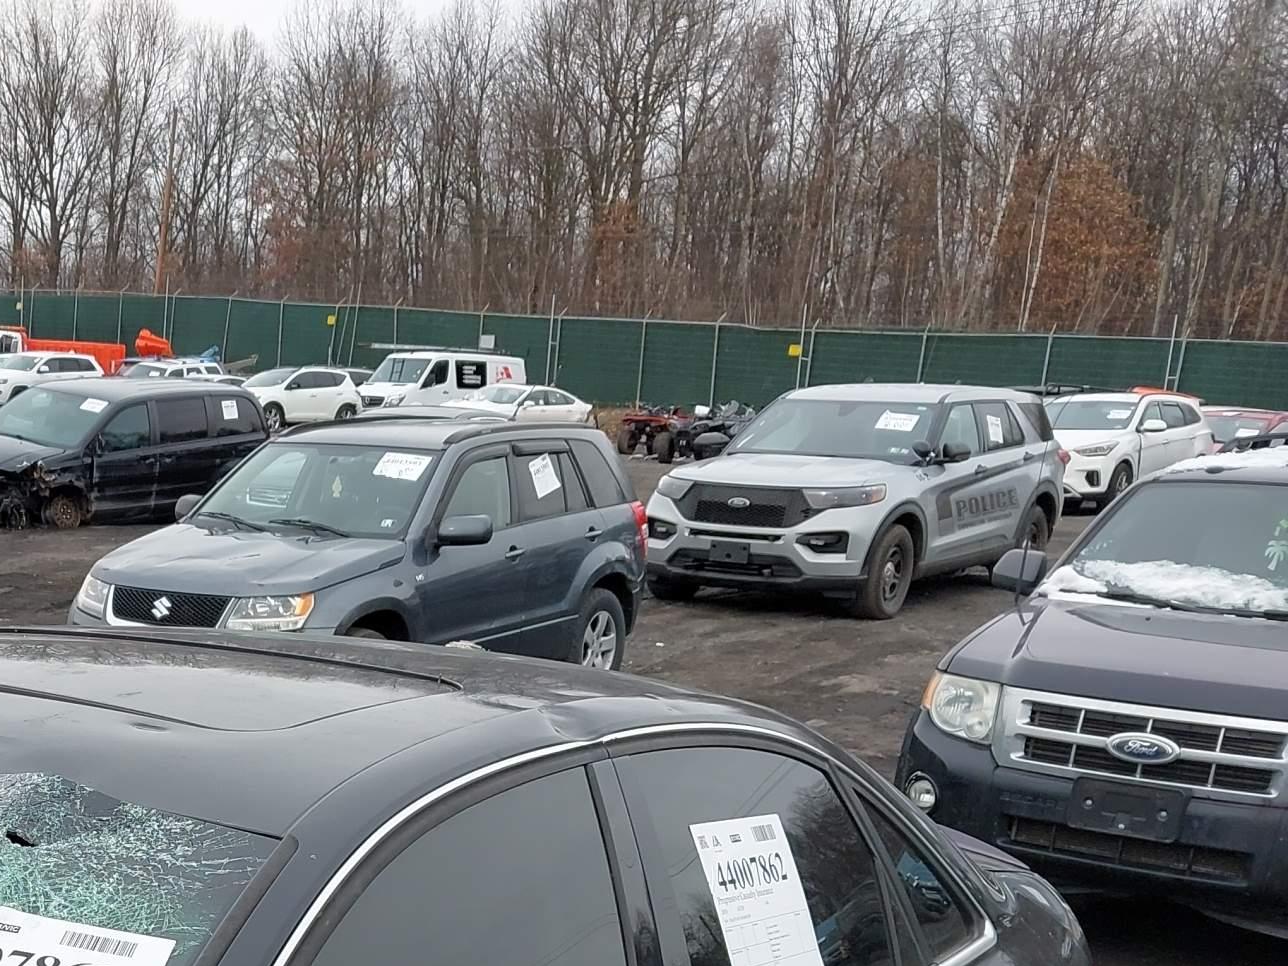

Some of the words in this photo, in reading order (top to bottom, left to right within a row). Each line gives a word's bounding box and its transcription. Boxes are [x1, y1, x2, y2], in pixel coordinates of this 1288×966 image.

[956, 487, 1018, 521] POLICE
[1124, 740, 1158, 755] Ford
[717, 852, 789, 893] 44007862
